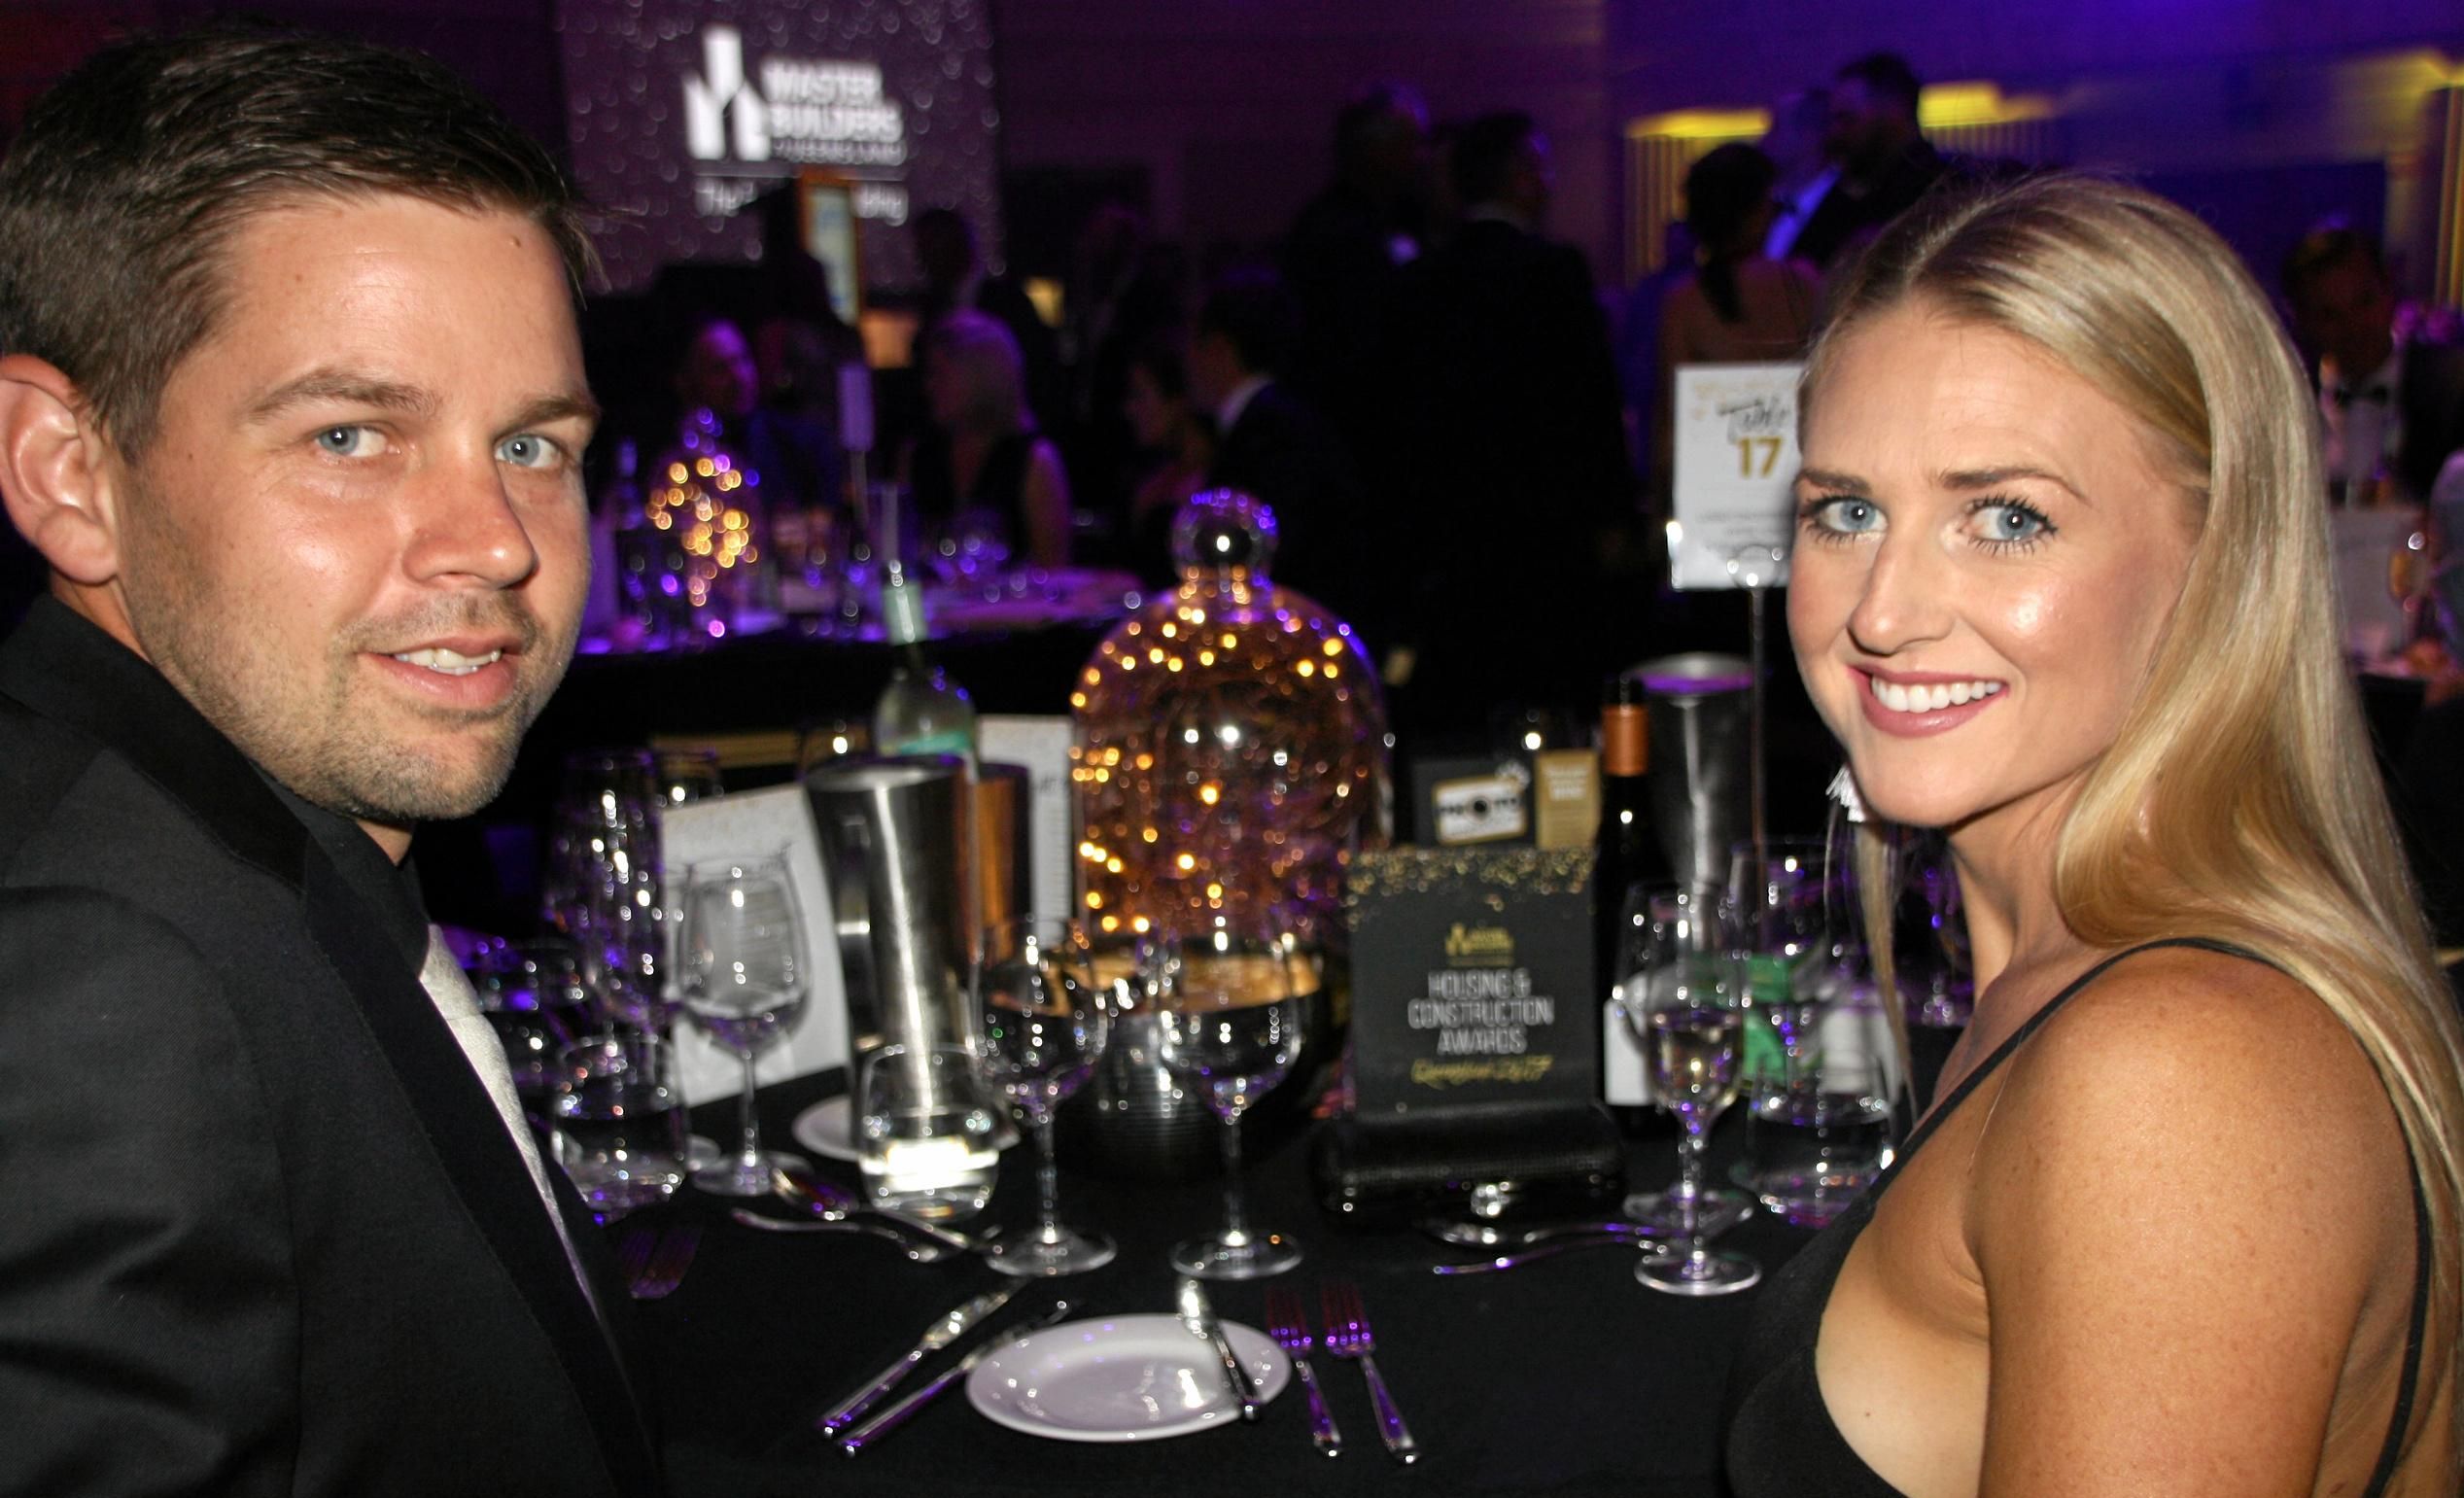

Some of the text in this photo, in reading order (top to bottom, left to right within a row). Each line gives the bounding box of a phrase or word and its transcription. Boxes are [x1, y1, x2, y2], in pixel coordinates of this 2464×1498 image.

[762, 60, 882, 105] MASTER
[768, 101, 903, 142] BUILDERS
[1737, 436, 1783, 478] 17
[1428, 970, 1512, 999] HOUSING
[1407, 996, 1555, 1028] CONSTRUCTION
[1437, 1028, 1528, 1056] AWARDS
